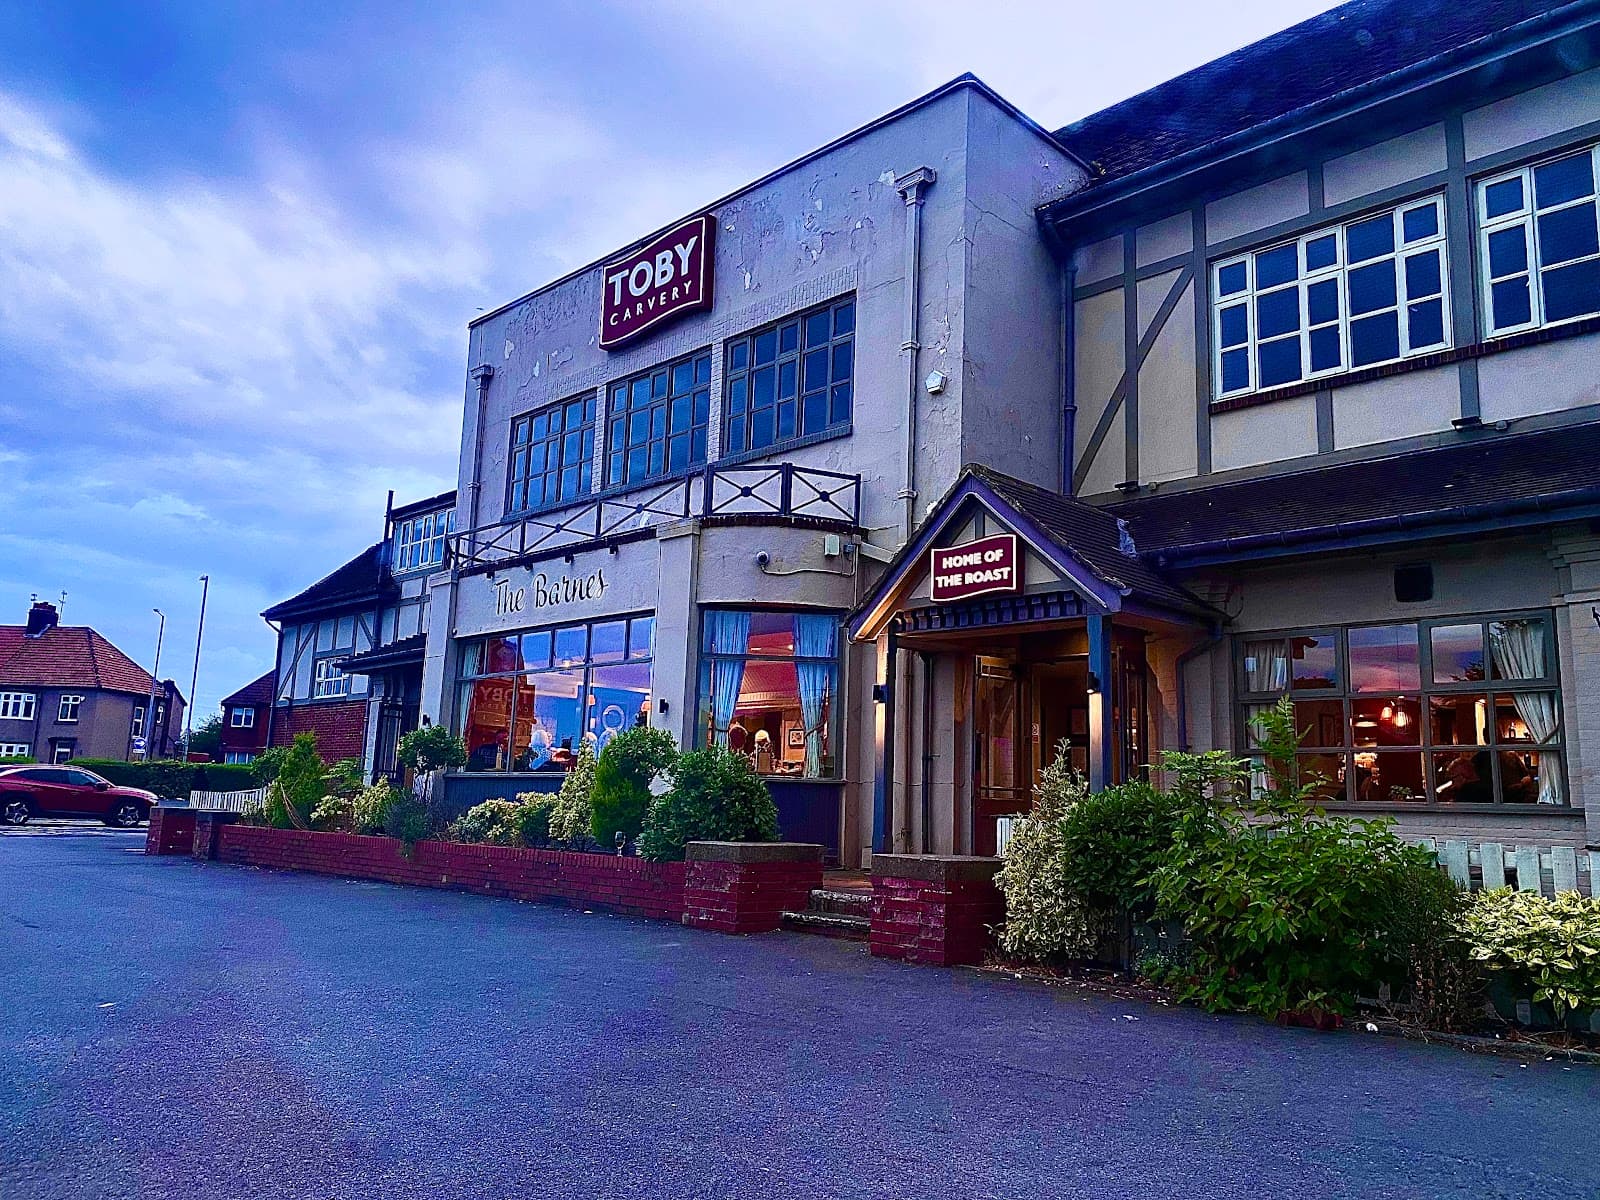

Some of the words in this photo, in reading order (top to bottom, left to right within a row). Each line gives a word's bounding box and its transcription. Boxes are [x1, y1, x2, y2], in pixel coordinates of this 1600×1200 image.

[608, 236, 698, 306] TOBY
[609, 280, 692, 326] CARVERY
[935, 574, 963, 588] THE
[964, 567, 1011, 584] ROAST
[942, 552, 982, 569] HOME
[984, 549, 1004, 563] OF
[494, 579, 525, 615] The
[533, 569, 608, 608] Barnes
